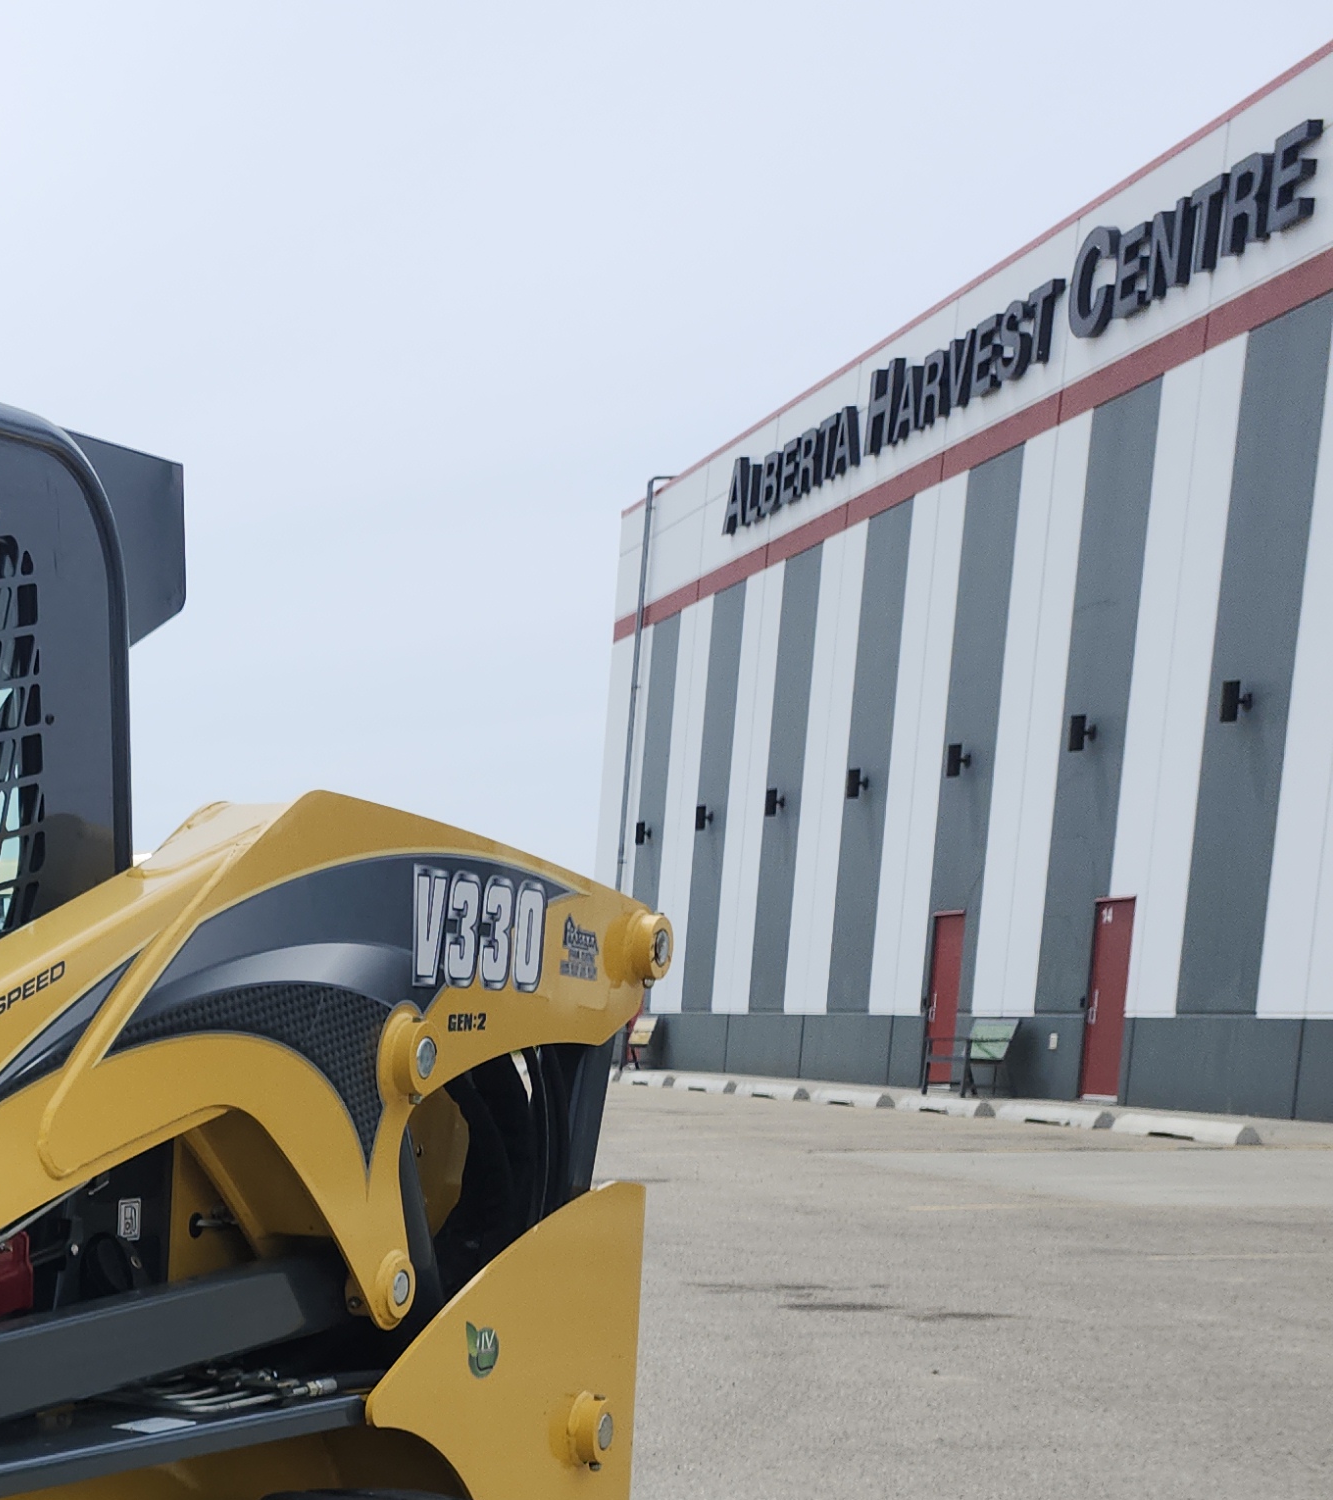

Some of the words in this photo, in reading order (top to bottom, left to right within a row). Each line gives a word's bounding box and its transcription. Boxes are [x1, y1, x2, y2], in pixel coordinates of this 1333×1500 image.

[722, 405, 861, 535] ALBERTA
[864, 278, 1066, 456] HARVEST
[1068, 119, 1324, 338] CENTRE
[412, 863, 549, 994] V330
[447, 1012, 487, 1032] GEN:2
